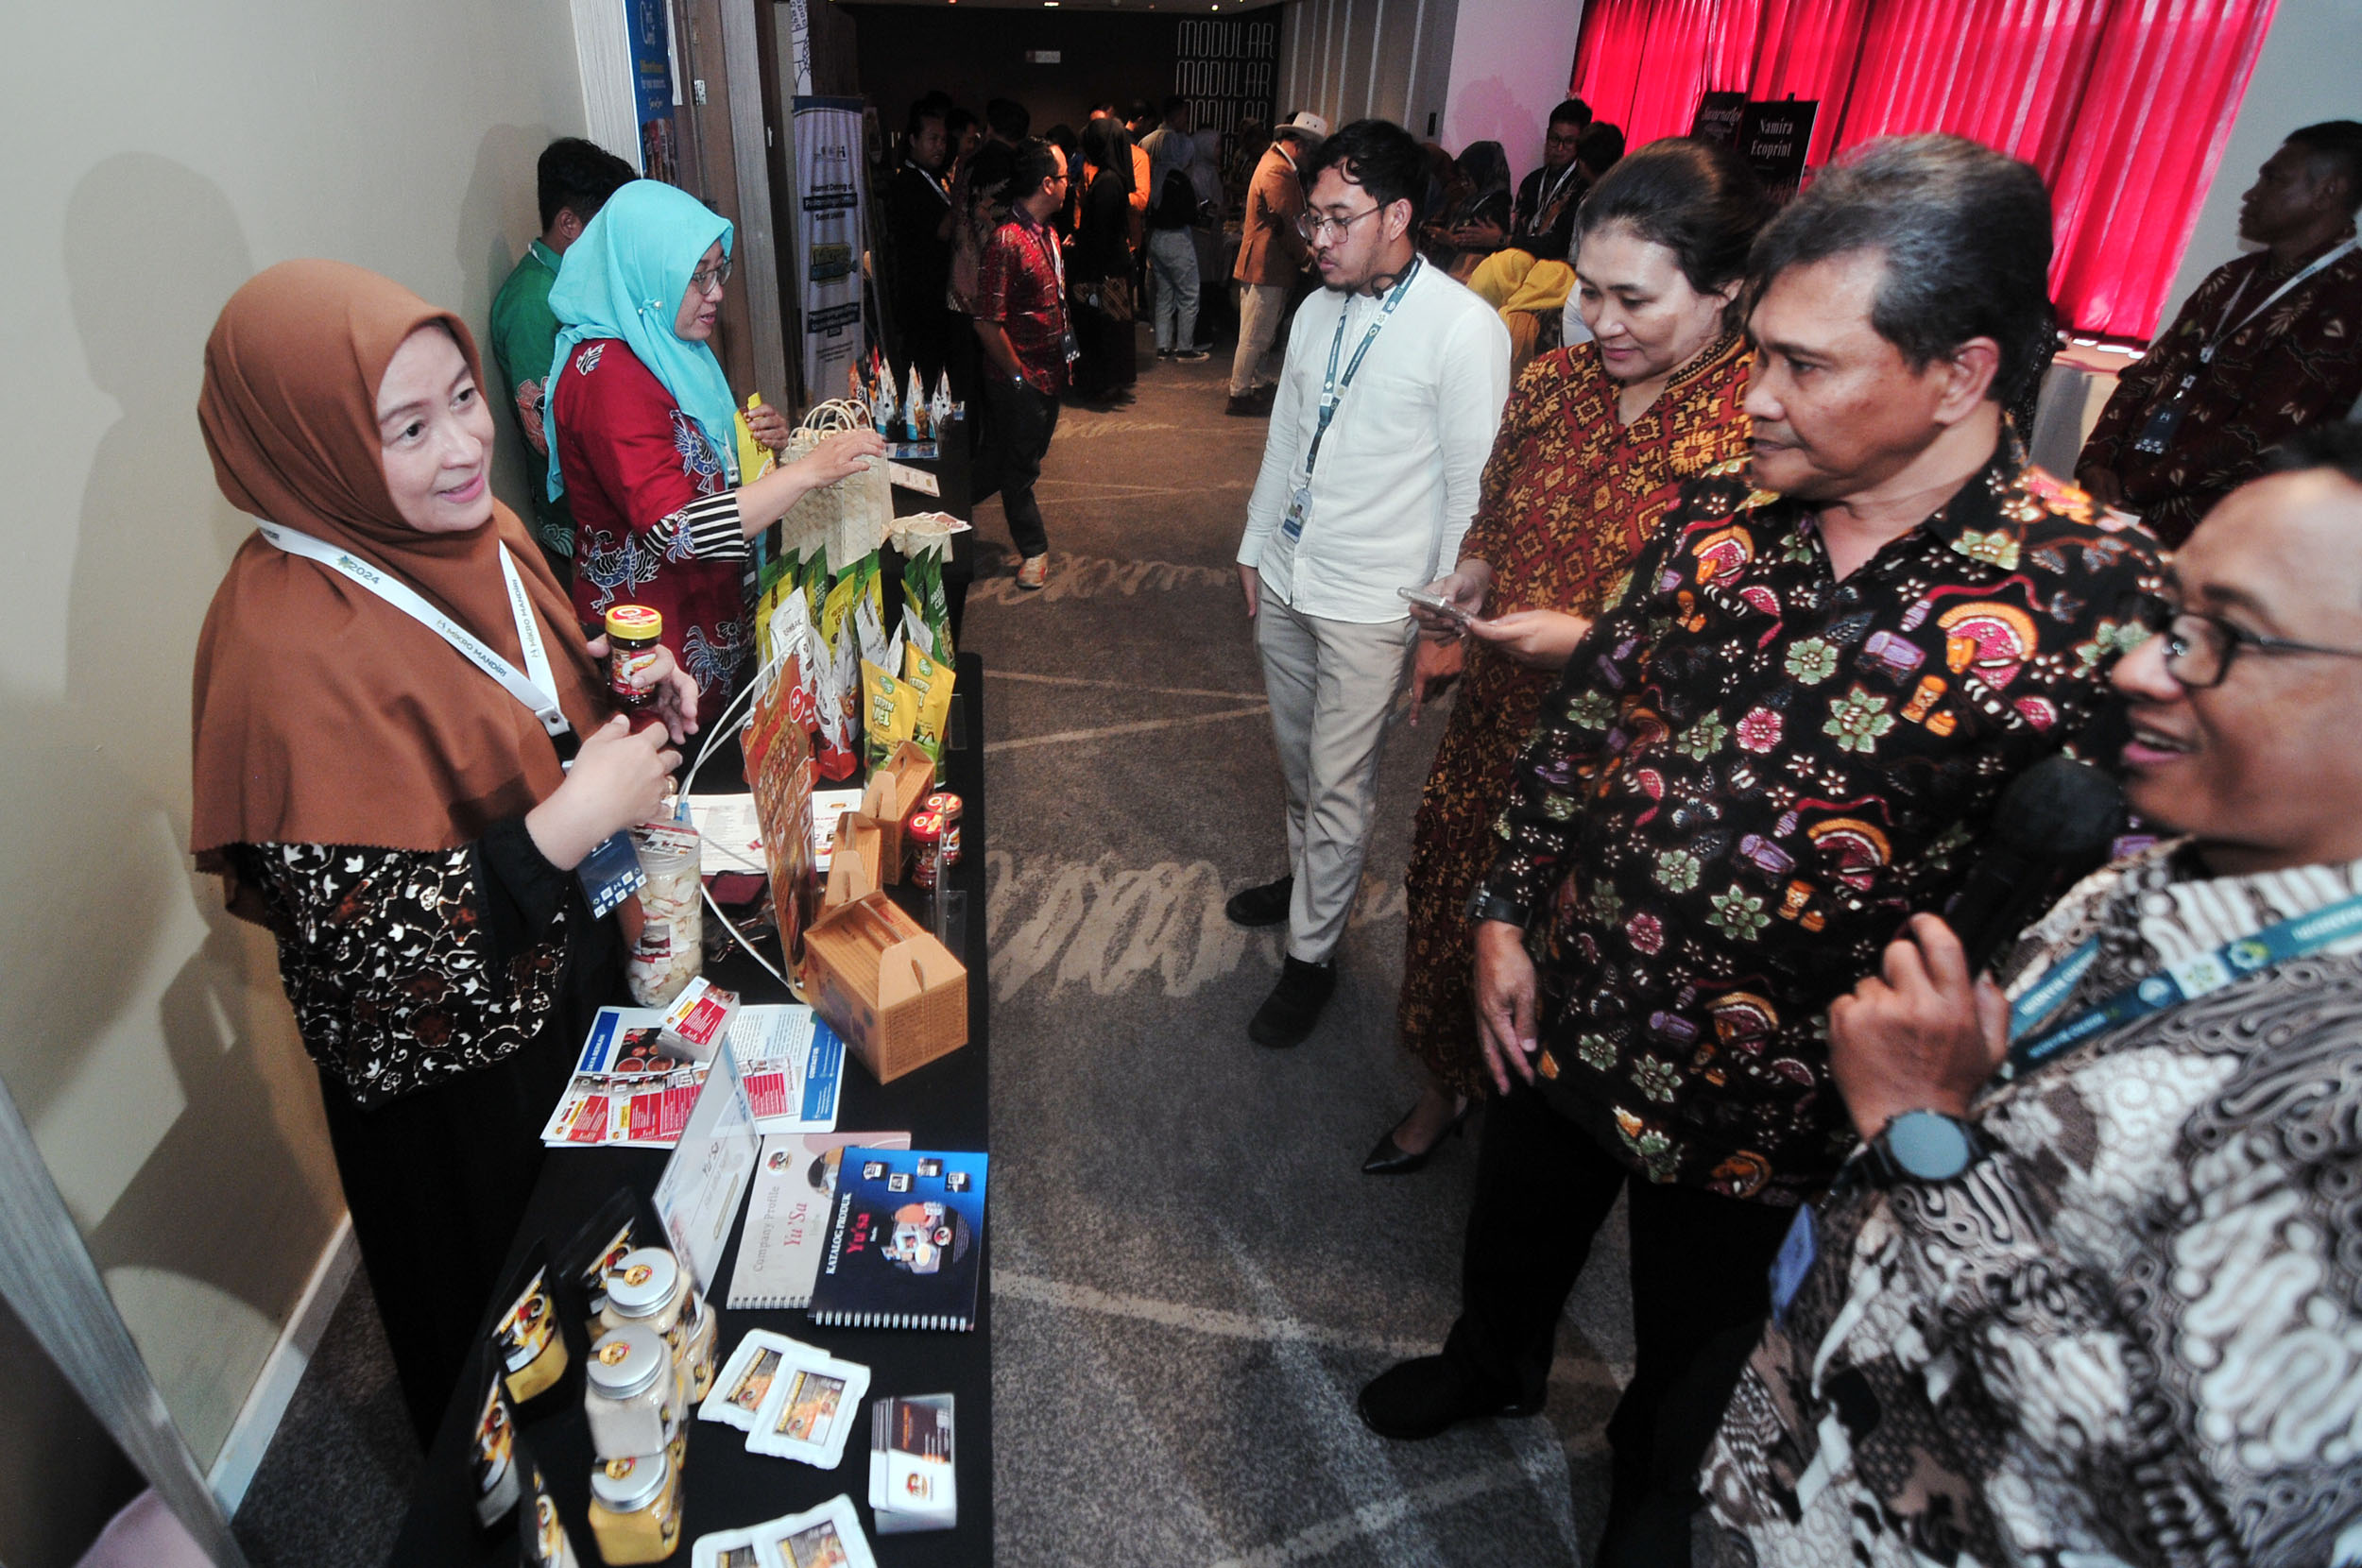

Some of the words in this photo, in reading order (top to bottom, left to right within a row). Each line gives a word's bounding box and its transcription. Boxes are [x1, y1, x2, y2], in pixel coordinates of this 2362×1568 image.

[1177, 20, 1275, 59] MODULAR
[1175, 60, 1271, 97] MODULAR
[1760, 118, 1793, 135] Namira
[1751, 140, 1792, 159] Ecoprint
[349, 562, 381, 585] 2024
[446, 627, 473, 652] MIKRO
[473, 646, 507, 677] MANDIRI
[753, 1220, 775, 1273] Company
[764, 1185, 779, 1219] Profile
[783, 1202, 808, 1247] Yu'Sa
[825, 1228, 846, 1276] KATALOG
[836, 1192, 853, 1229] PRODUK
